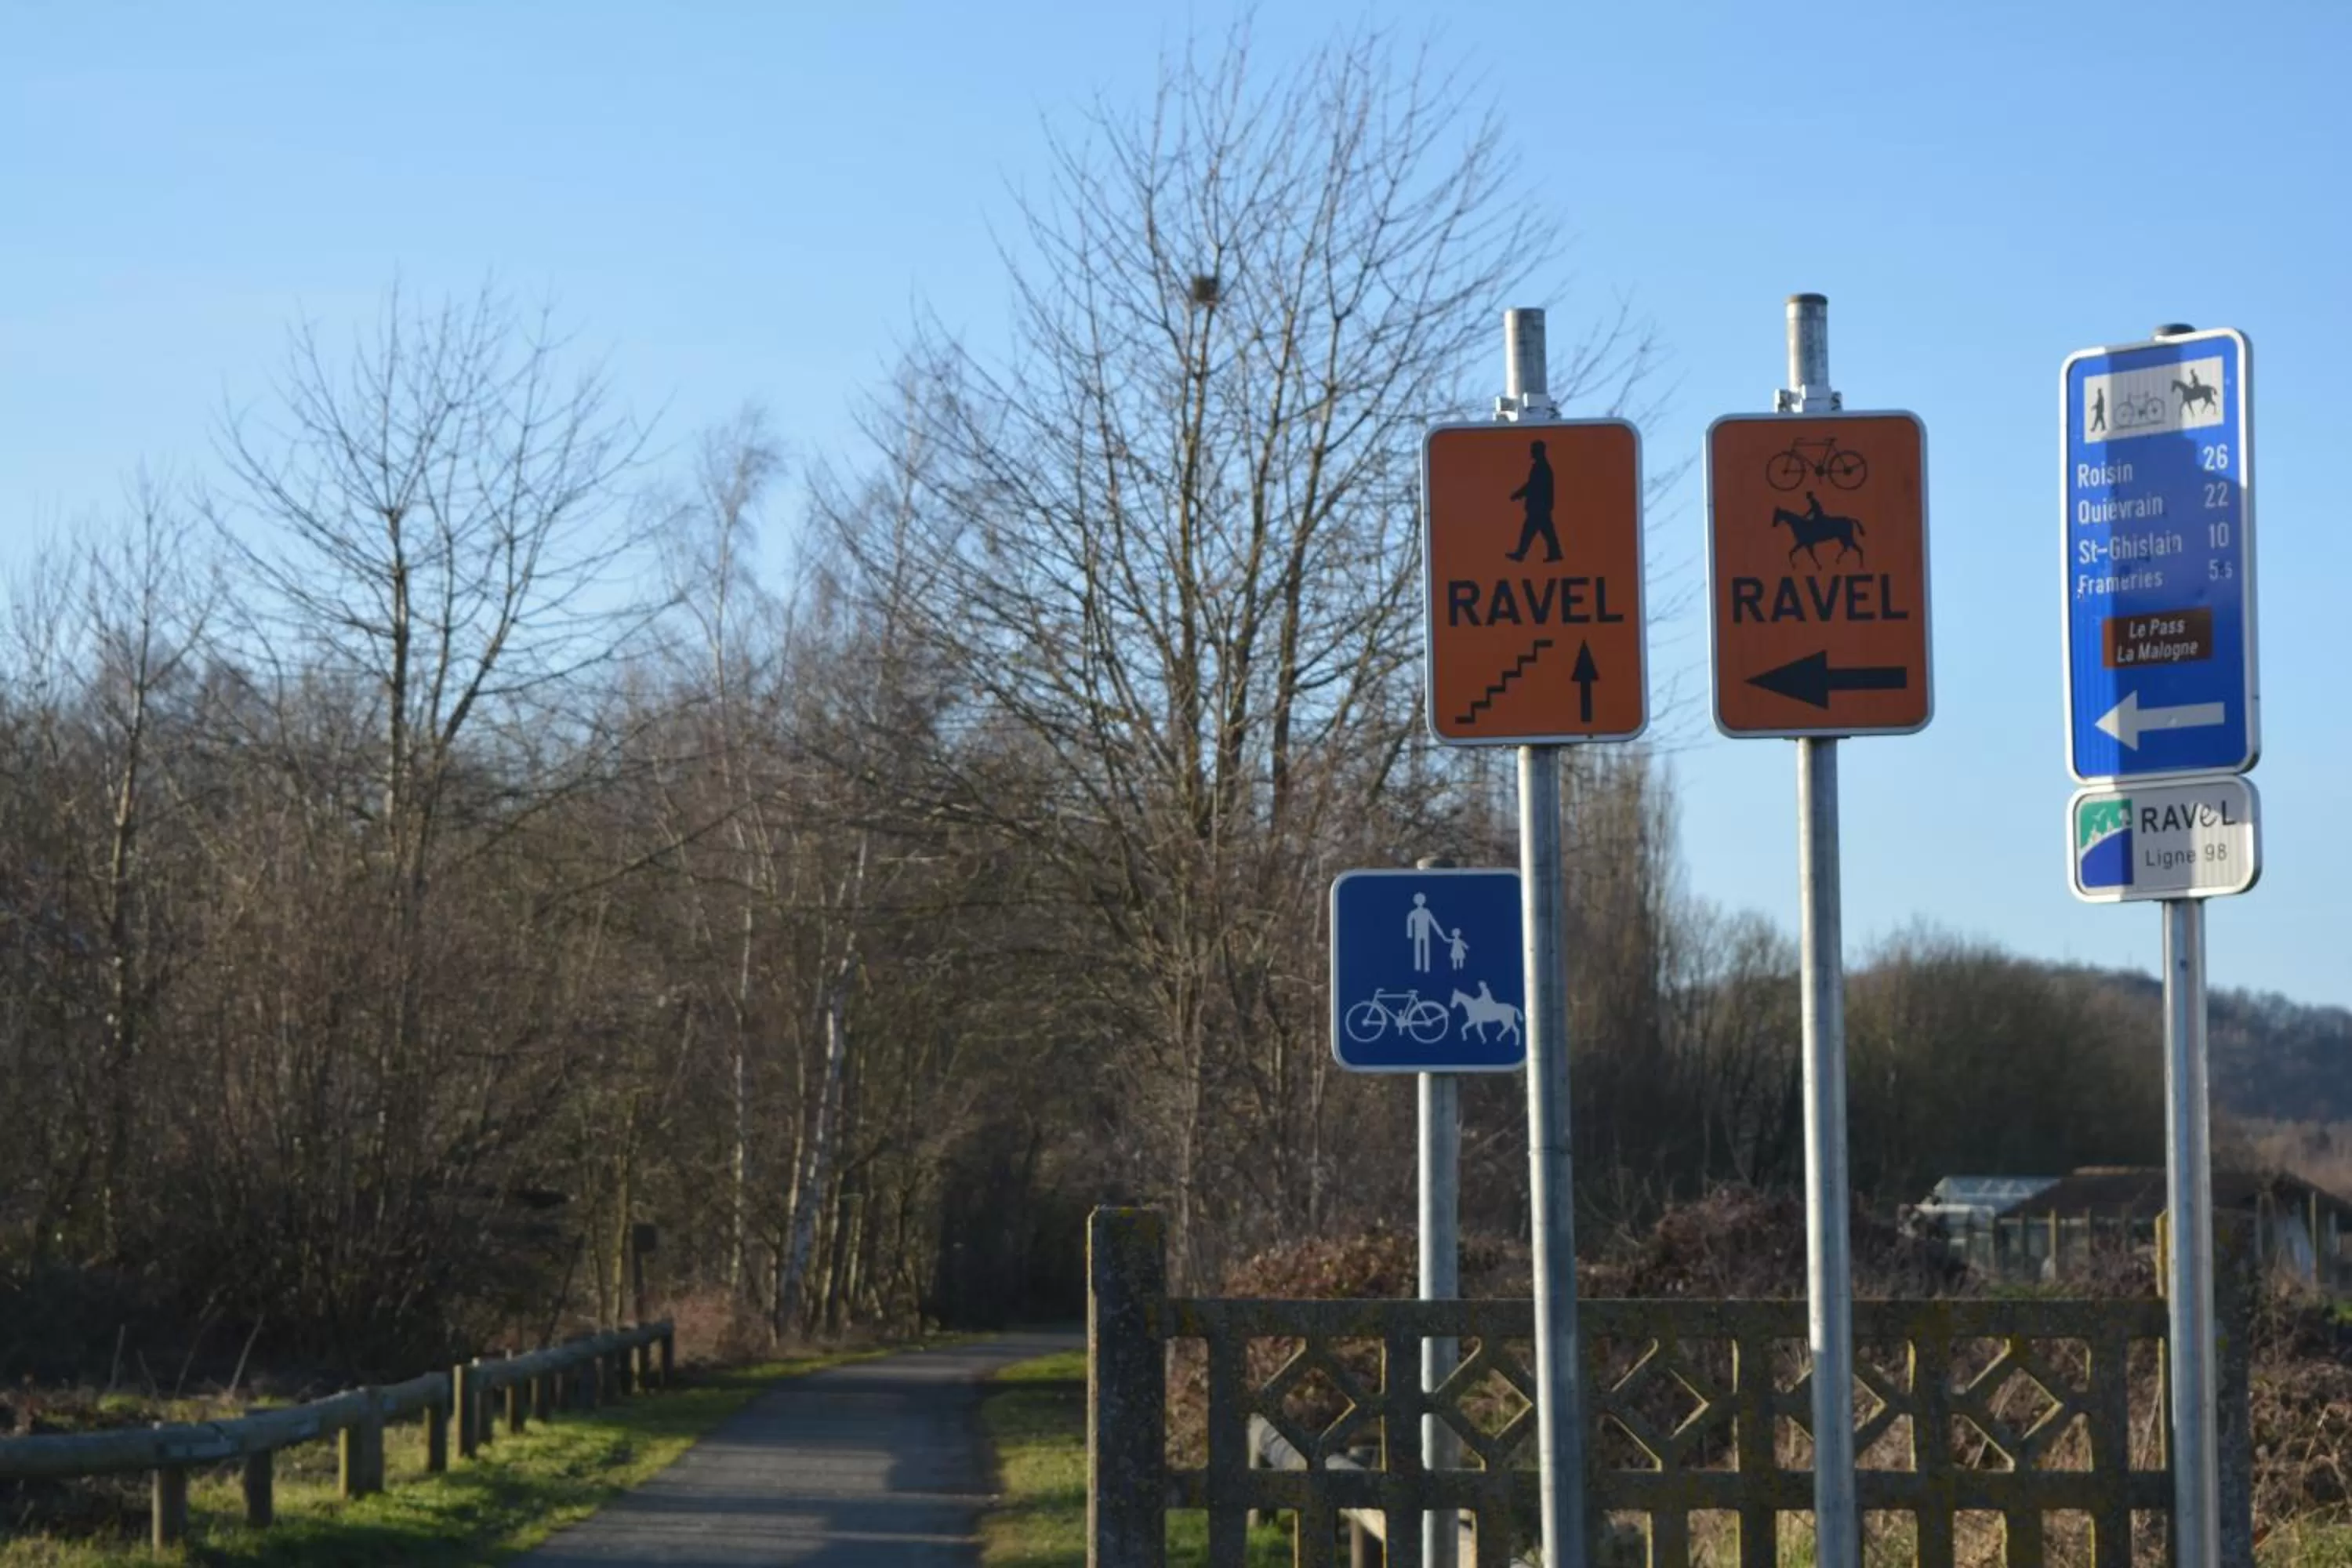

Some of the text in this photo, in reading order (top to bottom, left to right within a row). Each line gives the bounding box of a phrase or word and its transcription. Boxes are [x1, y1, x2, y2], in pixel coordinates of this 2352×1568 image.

[2078, 444, 2228, 488] Roisin 26
[2205, 481, 2229, 509] 22
[2079, 522, 2230, 564] St-Ghislain 10
[2078, 568, 2163, 594] Frameries
[1447, 577, 1624, 626] RAVEL
[1732, 574, 1908, 623] RAVEL
[2129, 618, 2186, 638] Le Pass
[2117, 641, 2199, 662] La Malogne
[2141, 800, 2237, 833] RAVeL
[2145, 843, 2228, 869] Ligne 98
